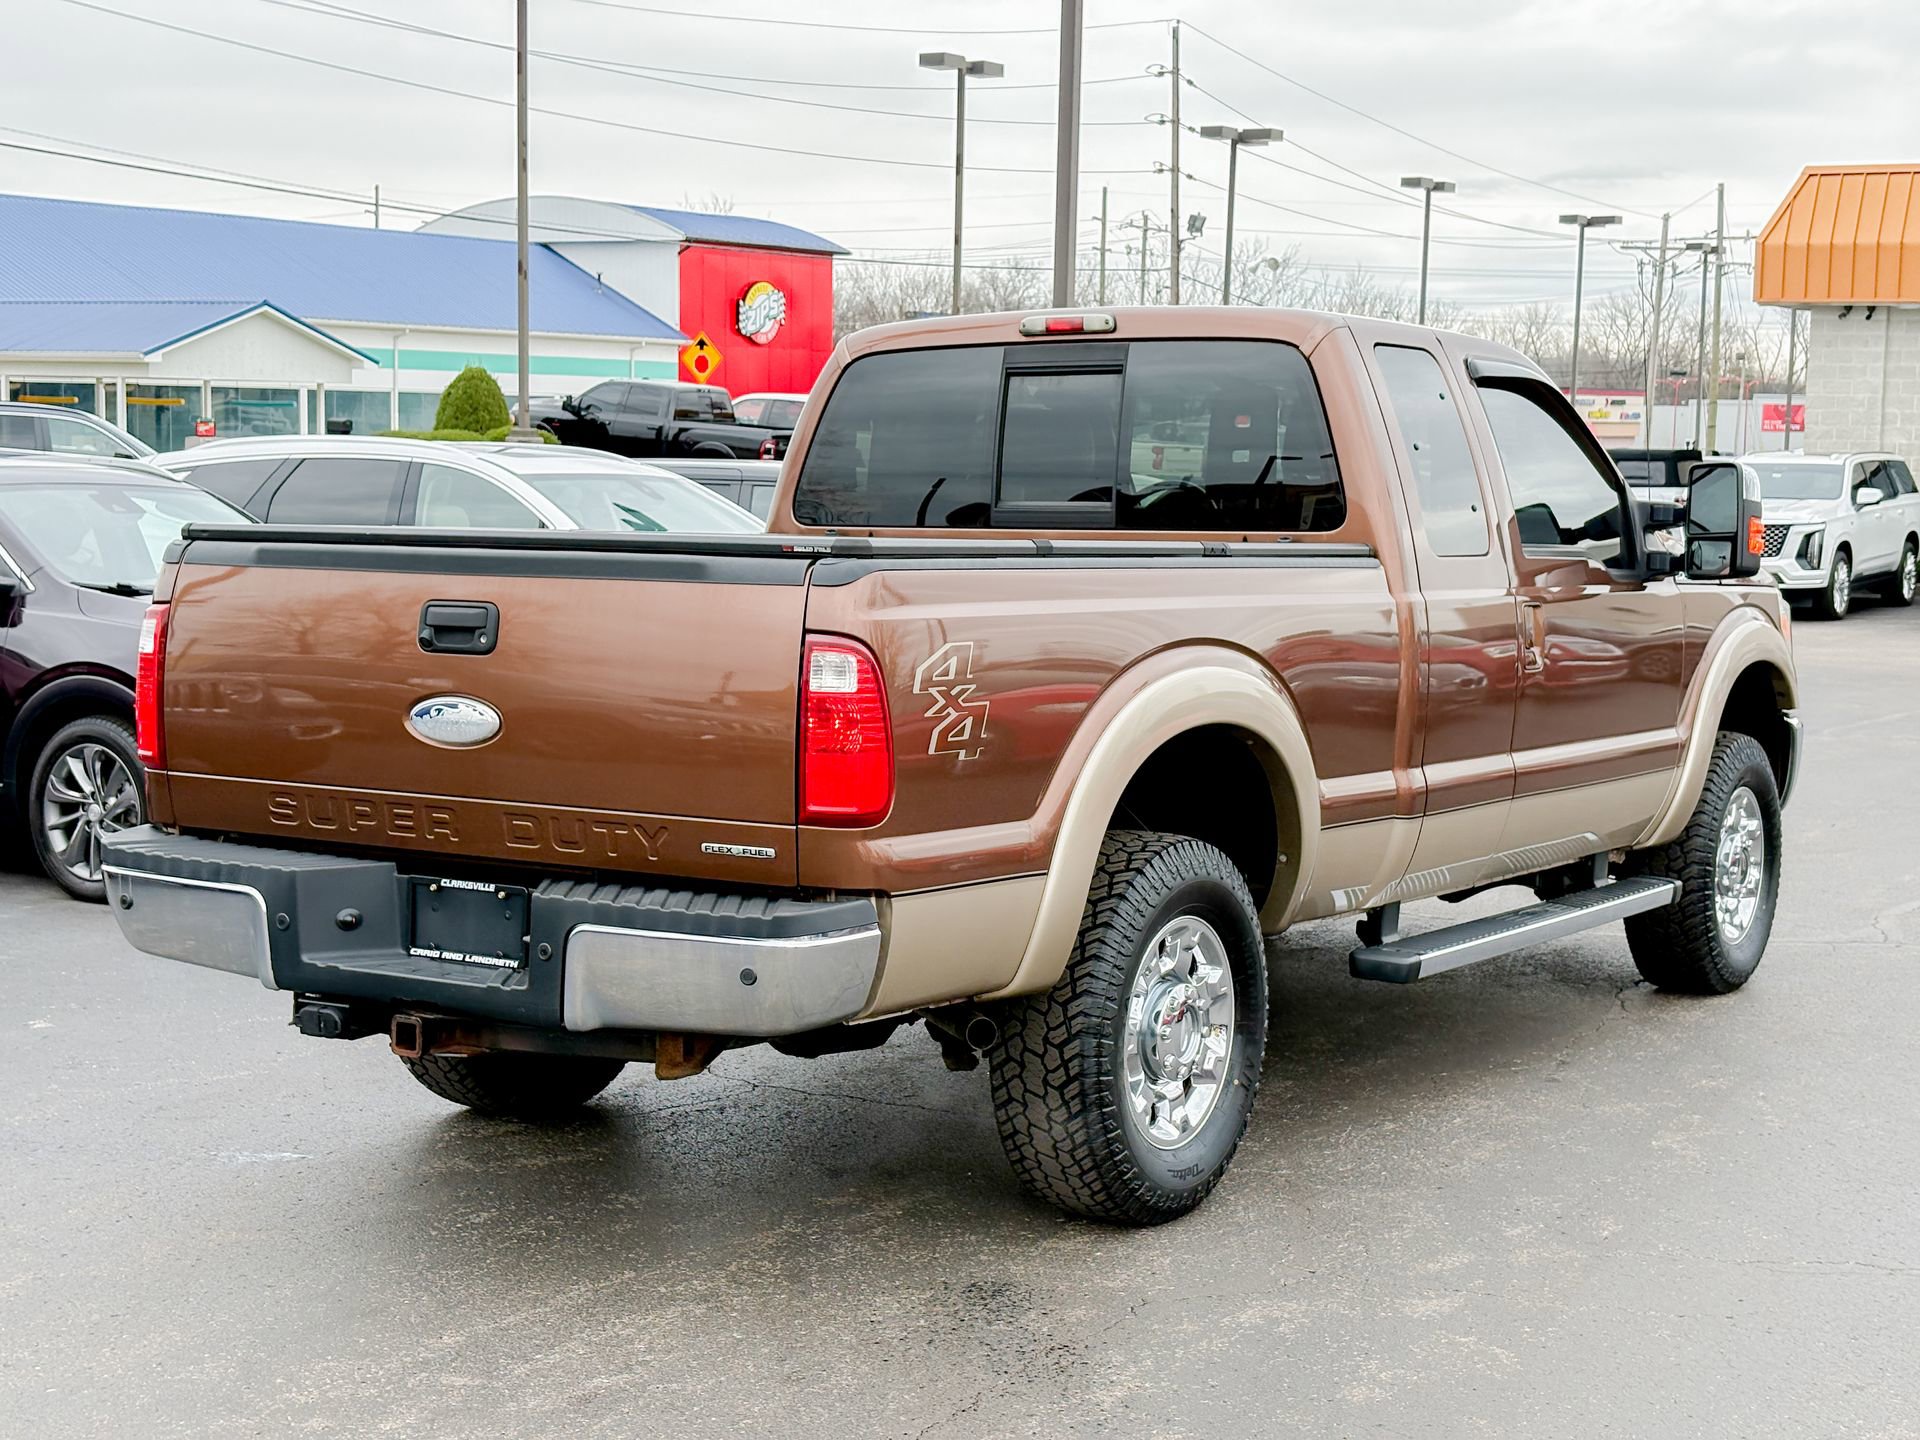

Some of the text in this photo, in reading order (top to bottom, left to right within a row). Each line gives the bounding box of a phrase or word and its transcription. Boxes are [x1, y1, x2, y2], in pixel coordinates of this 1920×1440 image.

[746, 293, 779, 331] ZIPS
[267, 790, 669, 861] SUPER DUTY
[704, 845, 772, 857] FLEX FUEL
[440, 878, 496, 892] CLARKSVILLE
[409, 947, 520, 969] CRAIG AND LANDRETH
